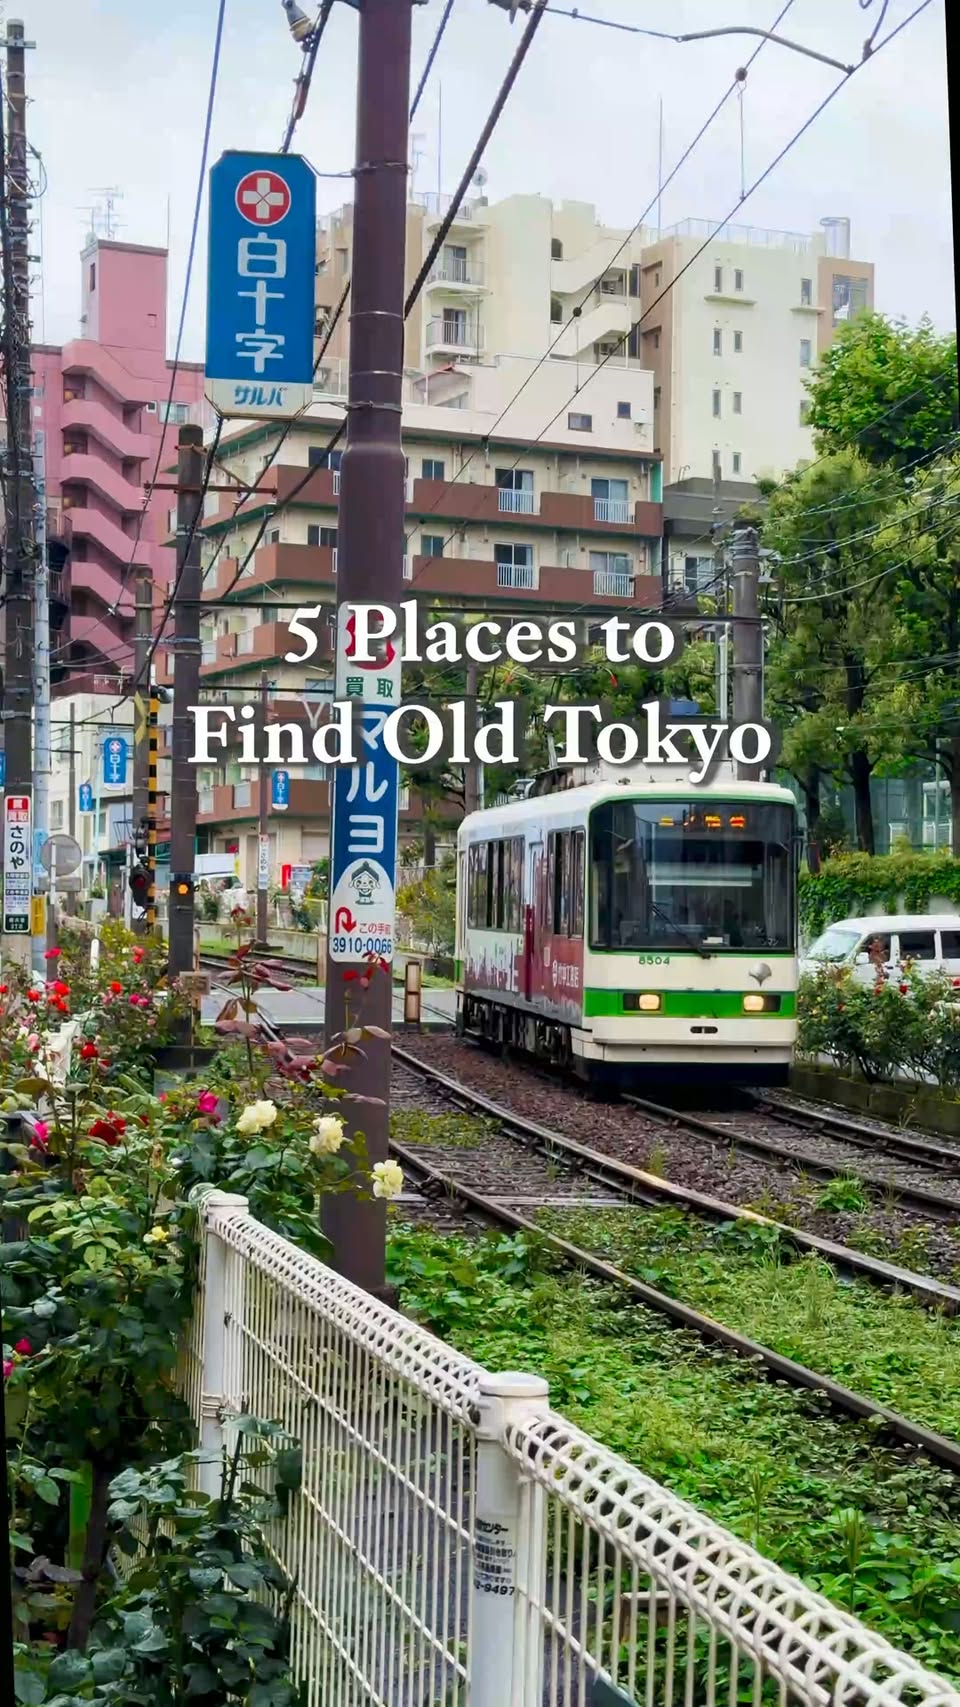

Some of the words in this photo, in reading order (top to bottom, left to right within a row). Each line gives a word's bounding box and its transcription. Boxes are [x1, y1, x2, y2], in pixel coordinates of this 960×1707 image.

[235, 231, 287, 373] 白十字
[234, 385, 288, 407] サルバ
[346, 676, 394, 698] 買取
[346, 710, 389, 853] マルヨ
[9, 825, 25, 869] さのや
[332, 936, 392, 955] 3910-0066
[638, 955, 670, 966] 8504
